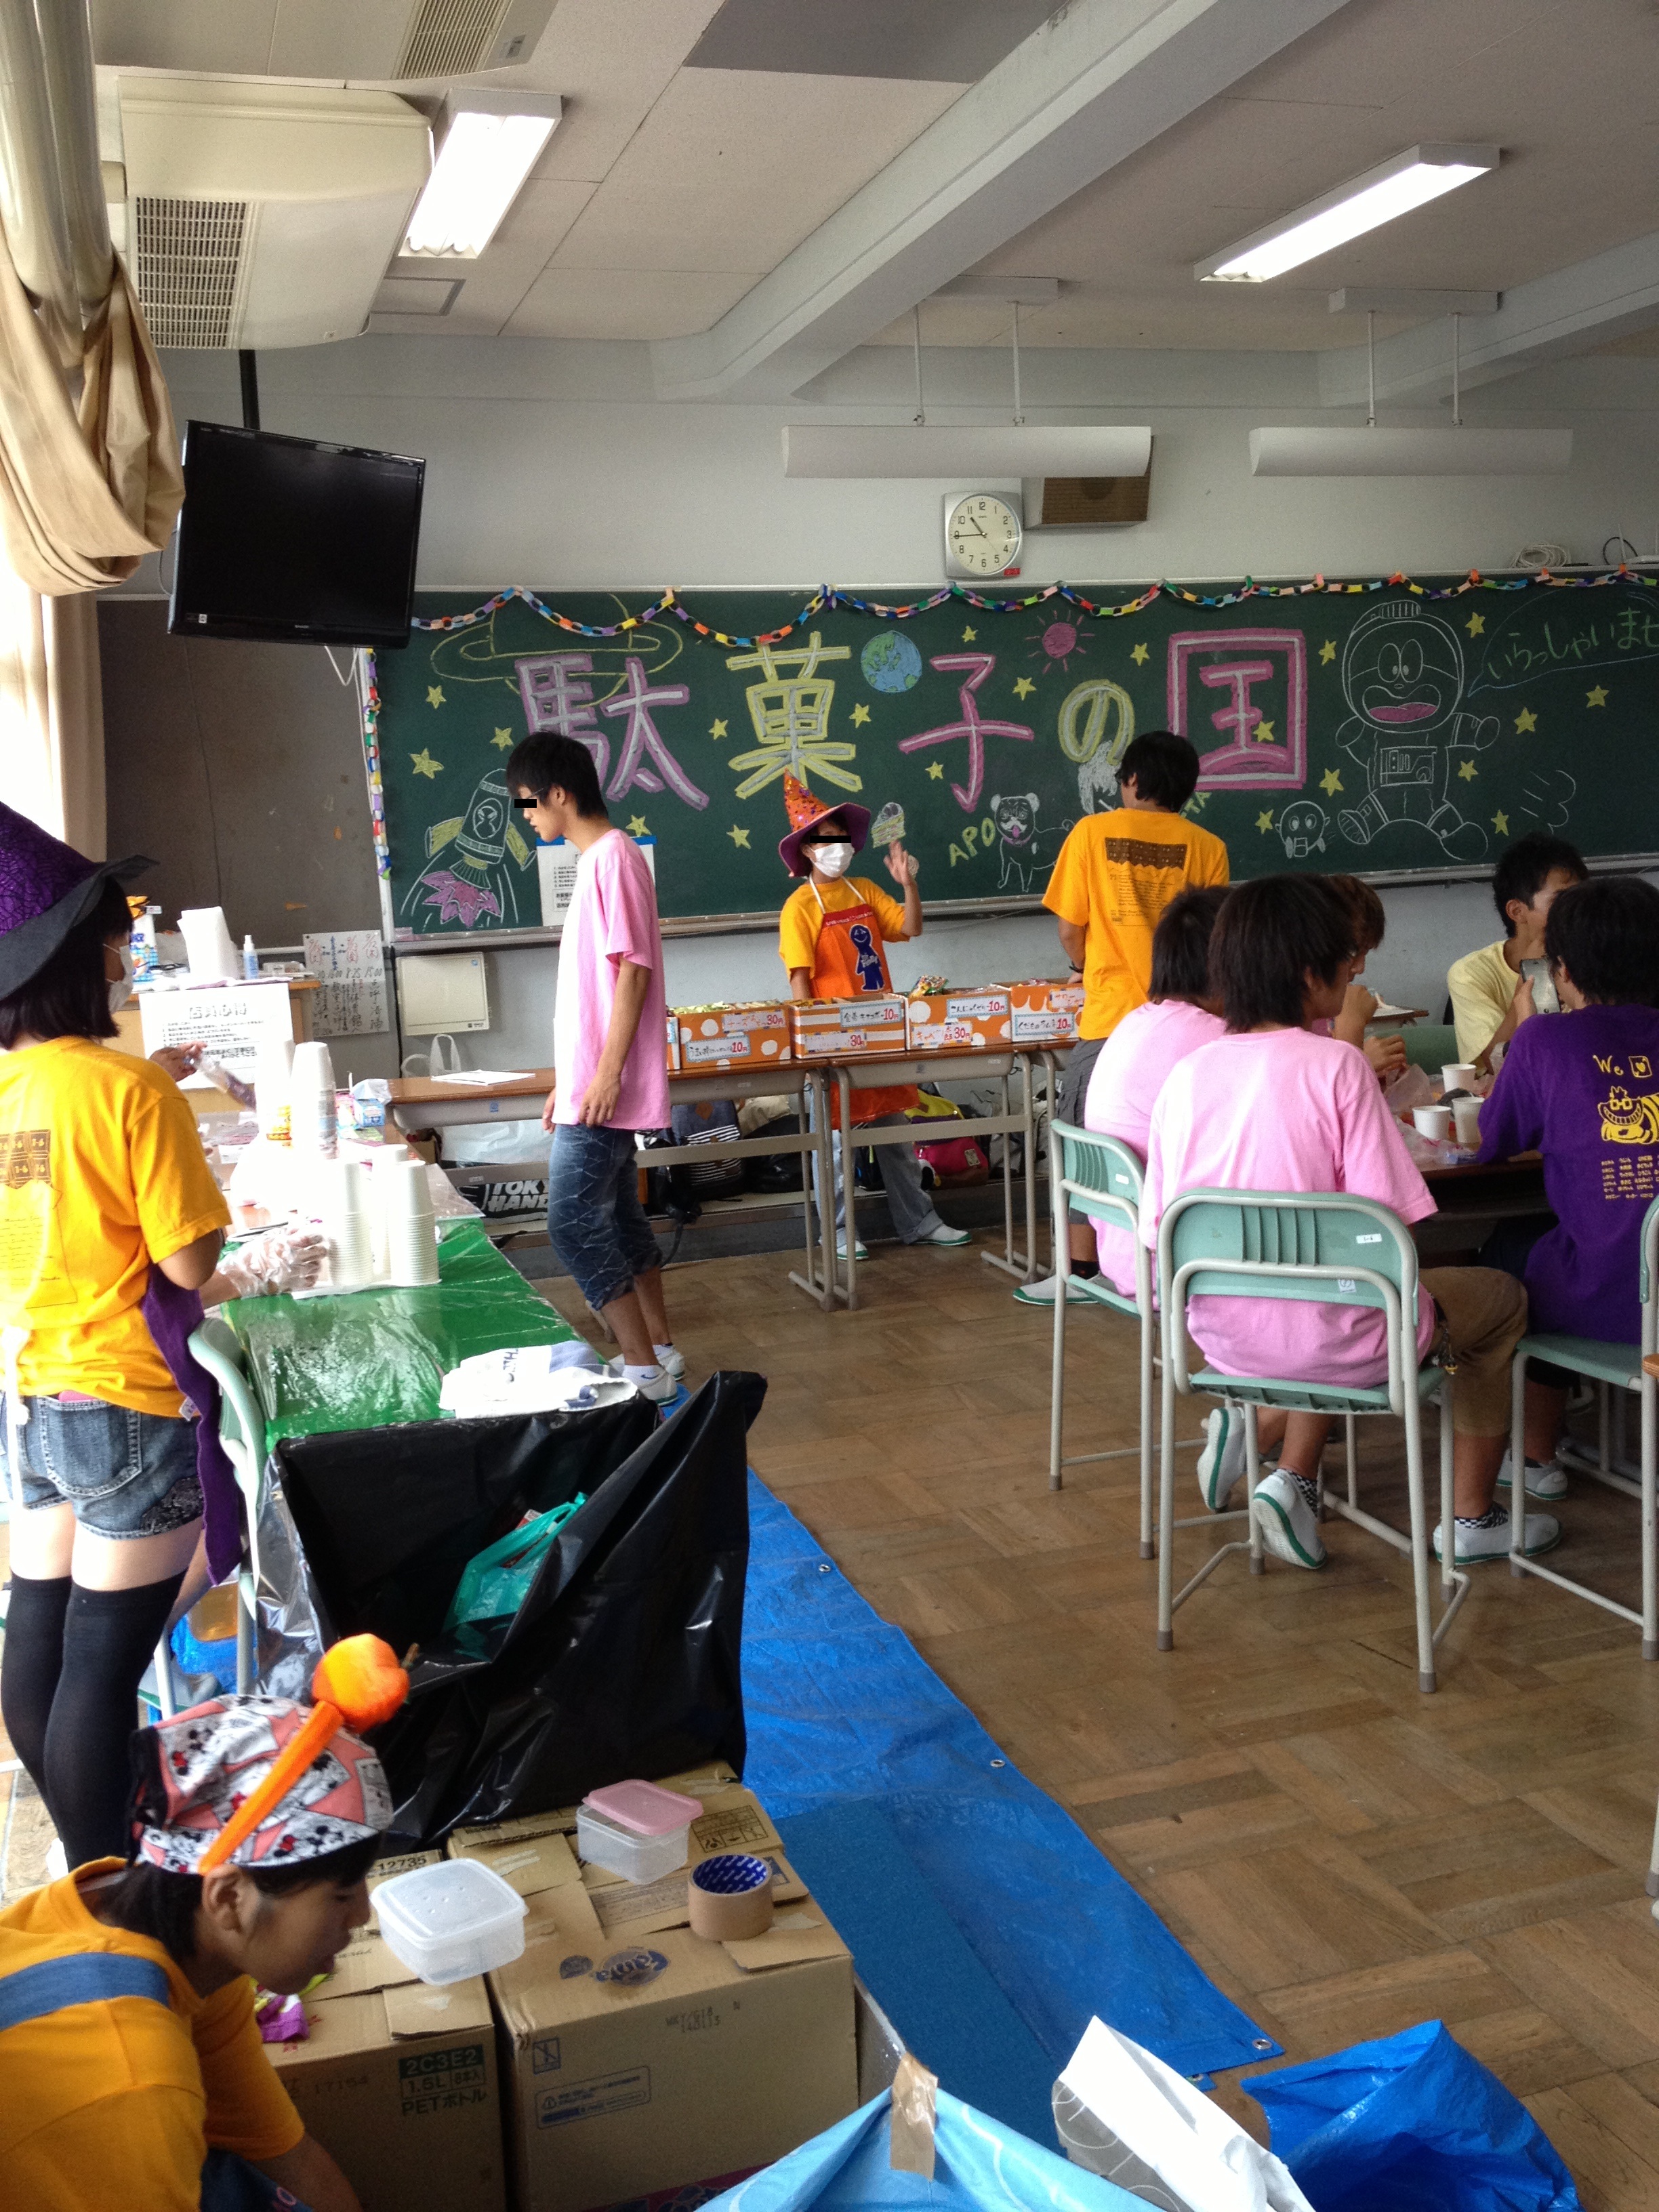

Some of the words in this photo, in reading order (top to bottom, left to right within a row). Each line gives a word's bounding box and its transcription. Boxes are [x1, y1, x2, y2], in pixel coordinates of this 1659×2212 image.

[967, 506, 972, 514] 11
[979, 501, 985, 510] 12
[958, 516, 966, 525] 10
[1003, 516, 1008, 525] 2
[1006, 530, 1012, 539] 3
[959, 545, 964, 554] 8
[1003, 545, 1008, 553] 4
[969, 554, 974, 563] 7
[981, 558, 986, 567] 6
[994, 554, 1000, 563] 5
[1487, 606, 1659, 680] いらっしゃいませ
[515, 628, 1307, 813] 駄菓子の国
[949, 817, 996, 867] APO
[1593, 1054, 1624, 1076] We
[406, 2049, 476, 2075] 2C3E2
